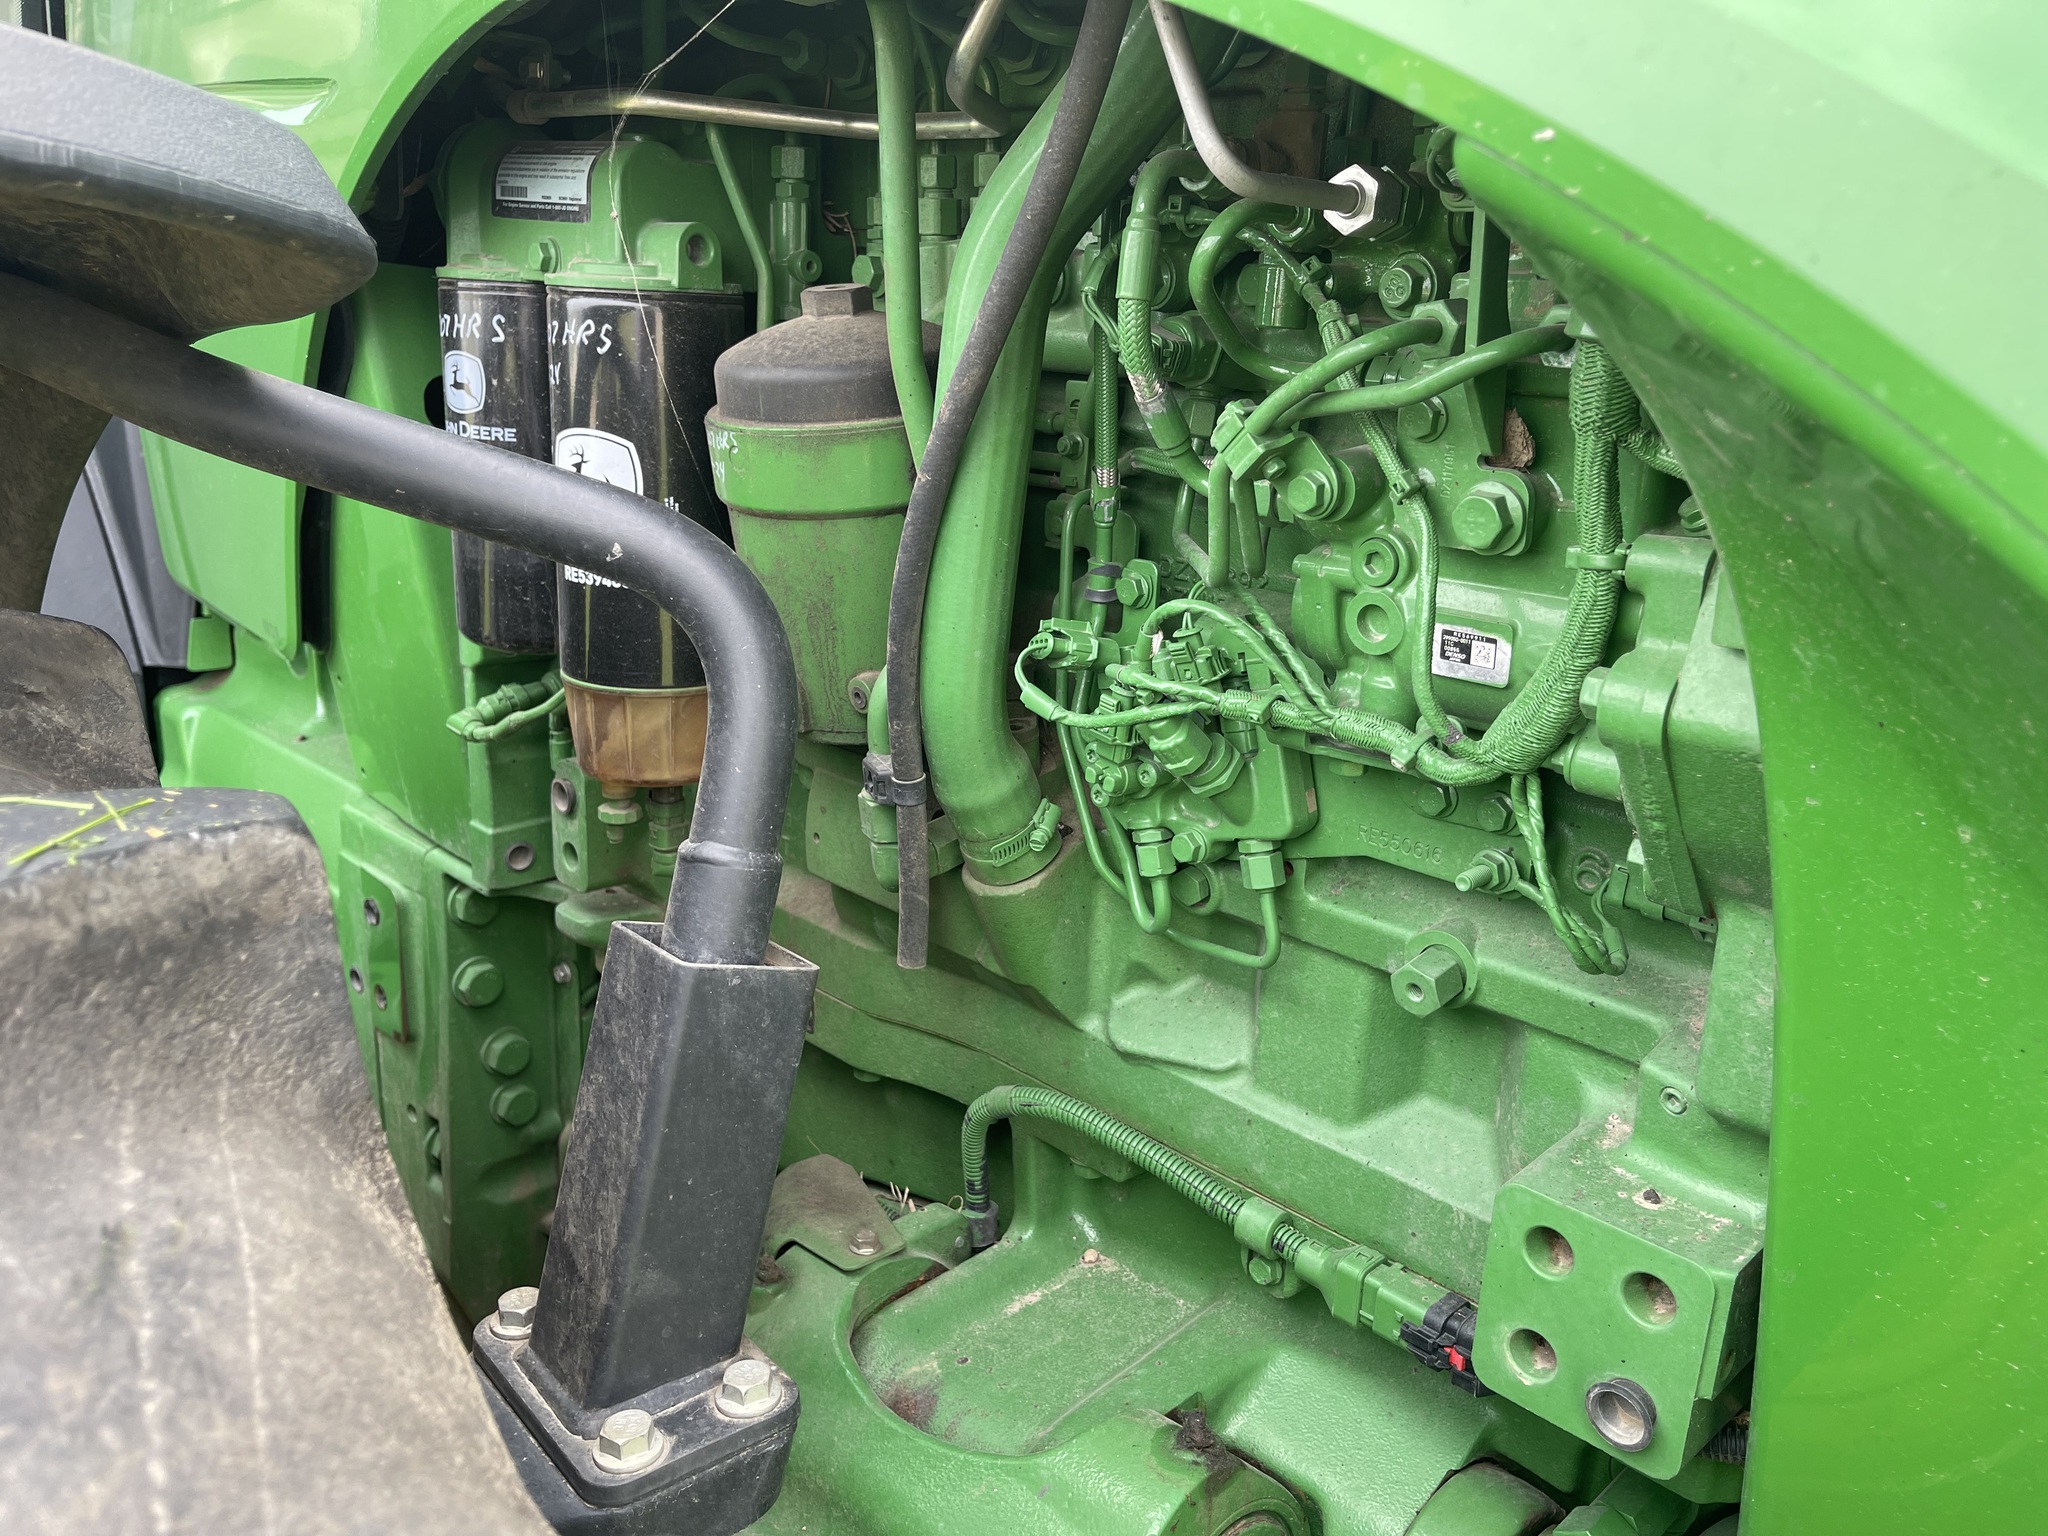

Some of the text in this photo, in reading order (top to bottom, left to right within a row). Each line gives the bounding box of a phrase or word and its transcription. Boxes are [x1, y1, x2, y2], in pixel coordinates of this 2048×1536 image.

[445, 419, 517, 442] HN DEERE
[564, 564, 629, 589] RE5394
[1445, 651, 1466, 660] DENSO
[1357, 824, 1442, 865] RE550616
